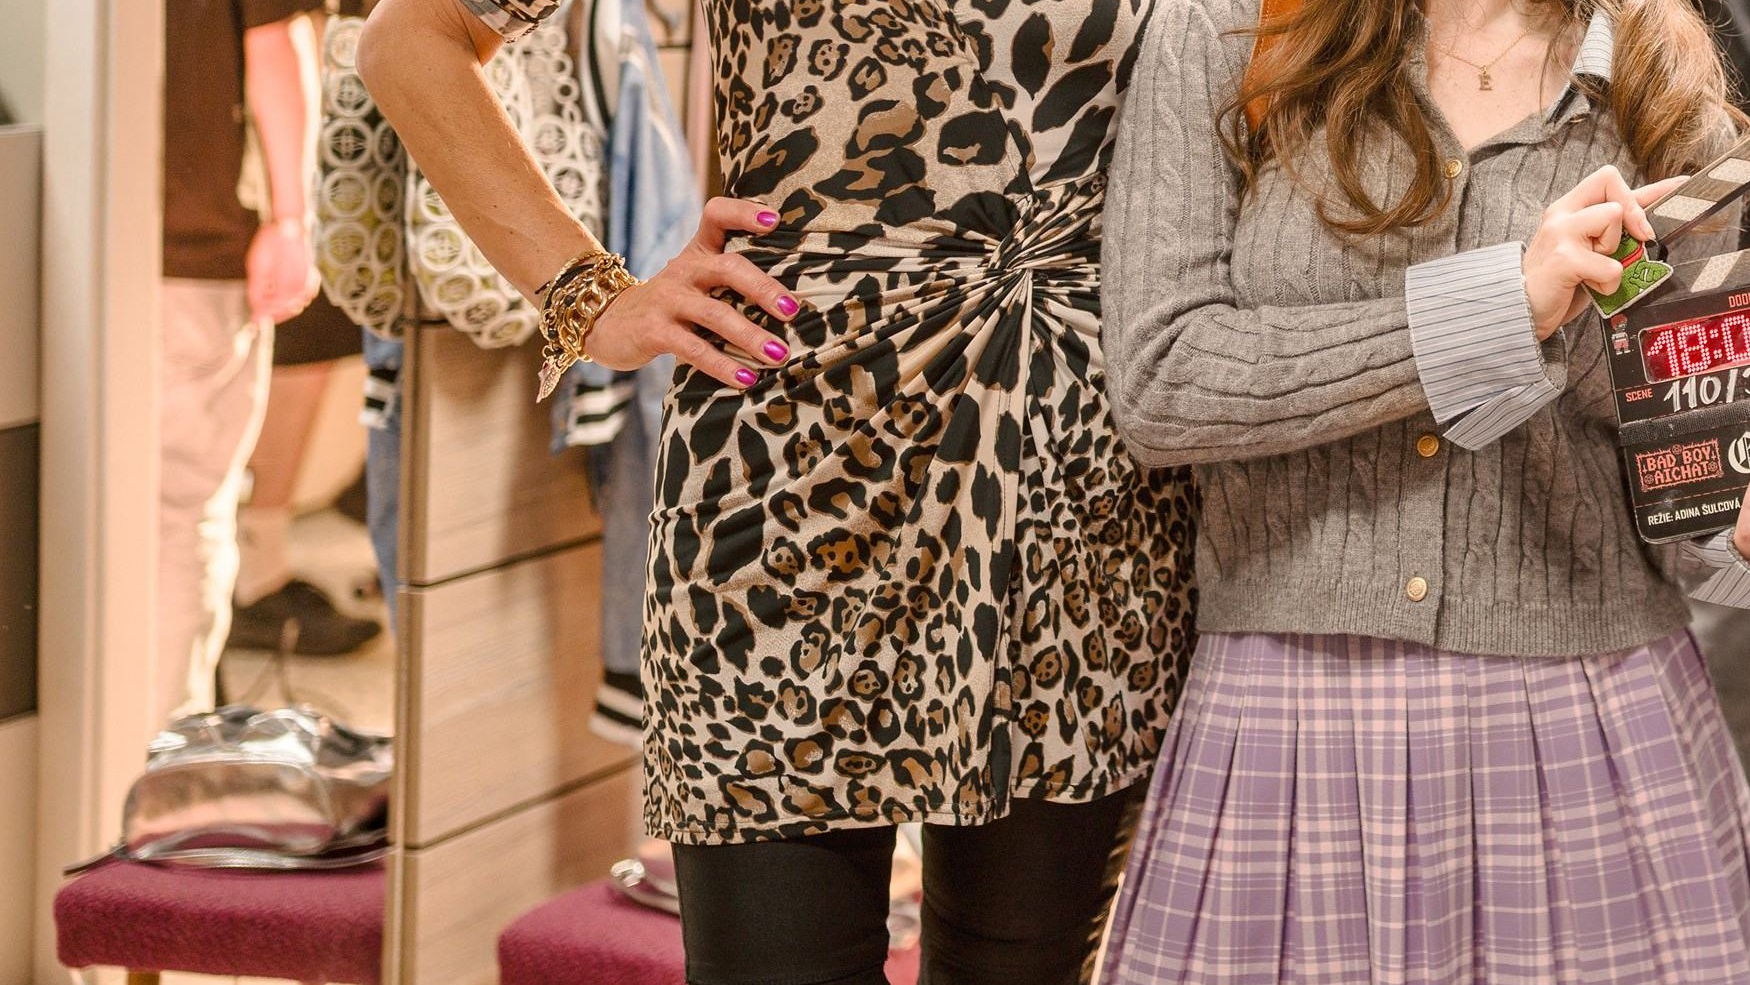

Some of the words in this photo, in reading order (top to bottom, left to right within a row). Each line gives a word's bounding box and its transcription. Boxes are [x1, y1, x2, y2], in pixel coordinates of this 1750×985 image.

[1625, 388, 1653, 402] SCENE
[1646, 453, 1676, 471] BAD
[1683, 446, 1711, 461] BOY
[1654, 460, 1710, 485] AICHAT
[1647, 512, 1674, 526] REŽIE:
[1675, 506, 1701, 521] ADINA
[1702, 497, 1741, 516] ŠULCOVÁ
